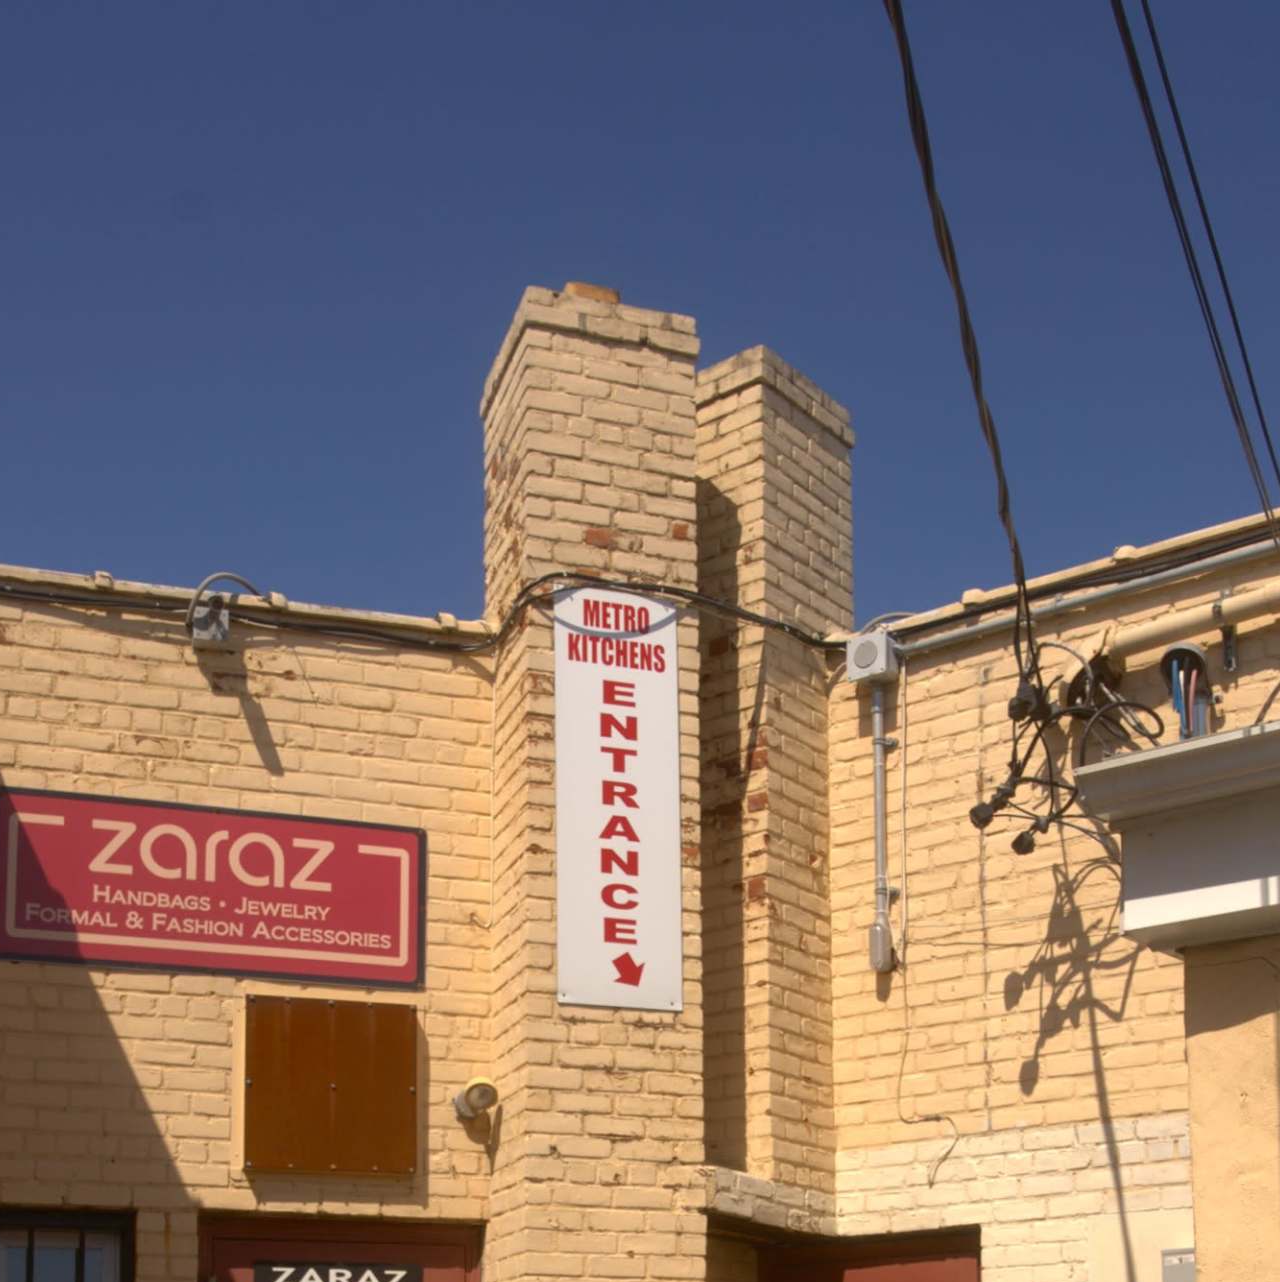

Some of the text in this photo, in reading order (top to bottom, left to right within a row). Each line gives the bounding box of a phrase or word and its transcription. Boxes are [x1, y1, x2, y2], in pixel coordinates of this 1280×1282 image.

[582, 598, 650, 634] METRO
[567, 632, 666, 673] KITCHENS
[599, 679, 641, 946] ENTRANCE
[87, 818, 336, 893] zaraz
[92, 883, 330, 922] HANDBAGS JEWELRY
[24, 902, 393, 951] FORMAL & FASHION ACCESSORIES
